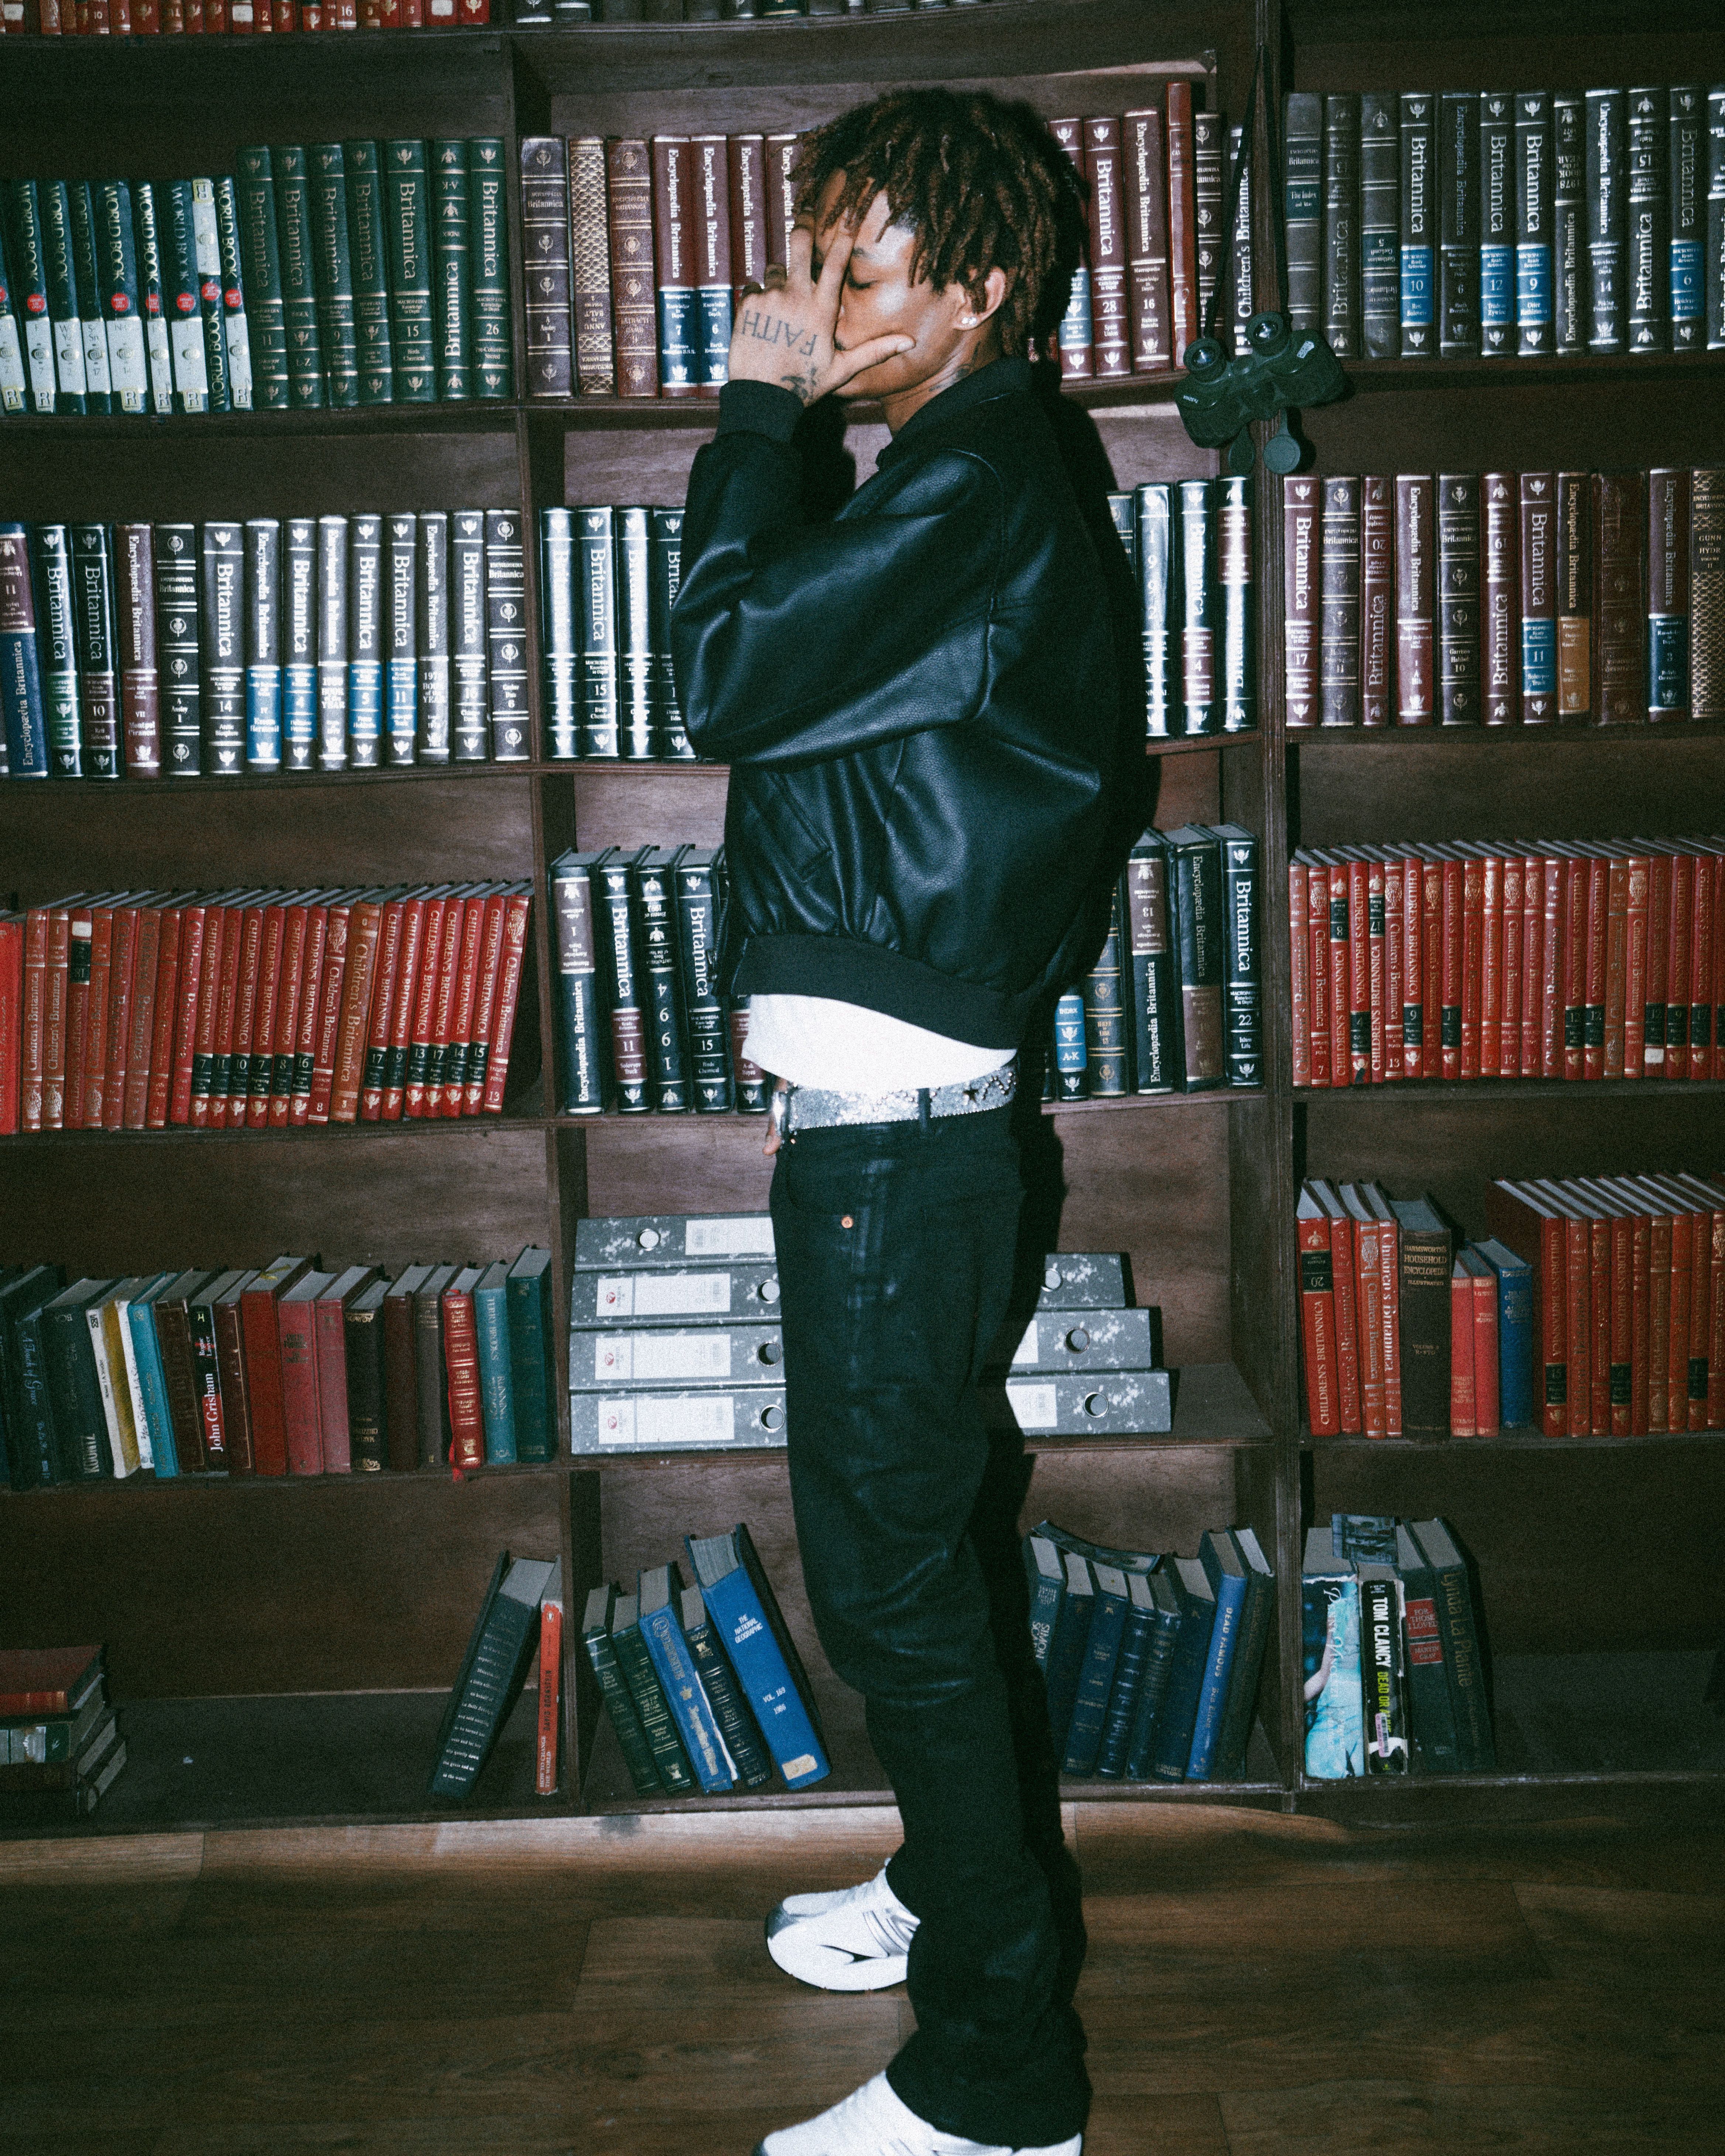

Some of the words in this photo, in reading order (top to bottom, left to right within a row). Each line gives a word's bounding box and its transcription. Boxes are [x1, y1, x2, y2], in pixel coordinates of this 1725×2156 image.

[341, 6, 353, 16] 16
[1639, 155, 1651, 166] 15
[218, 180, 233, 237] WORLD
[1097, 159, 1113, 256] Britannica
[1412, 137, 1427, 234] Britannica
[18, 184, 33, 237] WORLD
[49, 186, 64, 237] WORLD
[104, 186, 121, 238] WORLD
[138, 185, 155, 238] WORLD
[482, 182, 498, 277] Britannica
[1140, 197, 1150, 252] Britannica
[222, 237, 237, 278] BOOK
[251, 192, 270, 289] Britannica
[285, 190, 305, 286] Britannica
[320, 187, 339, 284] Britannica
[671, 223, 682, 278] Britannica
[707, 222, 719, 277] Britannica
[24, 242, 38, 281] BOOK
[54, 243, 68, 282] BOOK
[110, 243, 125, 282] BOOK
[145, 242, 159, 282] BOOK
[1411, 281, 1423, 291] 10
[1491, 280, 1502, 291] 12
[1530, 279, 1537, 290] 9
[1600, 281, 1611, 291] 14
[1636, 213, 1652, 310] Britannica
[1684, 276, 1691, 285] 6
[445, 262, 460, 357] Britannica
[1103, 301, 1116, 312] 28
[1144, 299, 1155, 309] 16
[208, 310, 220, 351] BOOK
[407, 326, 419, 336] 15
[486, 324, 499, 335] 26
[676, 326, 681, 335] 7
[743, 309, 817, 357] FAITH
[209, 356, 225, 406] WORLD
[1296, 516, 1311, 610] Britannica
[1372, 539, 1386, 550] 20
[1532, 513, 1547, 607] Britannica
[294, 560, 310, 653] Britannica
[359, 556, 376, 649] Britannica
[394, 555, 410, 647] Britannica
[463, 552, 478, 644] Britannica
[591, 548, 606, 641] Britannica
[1412, 557, 1421, 611] Britannica
[1569, 555, 1579, 609] Britannica
[47, 567, 67, 659] Britannica
[85, 566, 104, 659] Britannica
[131, 608, 142, 661] Britannica
[217, 563, 233, 657] Britannica
[1295, 654, 1307, 665] 17
[1534, 651, 1543, 662] 11
[93, 706, 104, 716] 10
[219, 701, 232, 712] 14
[594, 684, 606, 695] 15
[1354, 876, 1364, 938] CHILDREN'S
[1409, 870, 1418, 931] CHILDREN'S
[383, 913, 397, 975] CHILDREN'S
[404, 913, 417, 974] CHILDREN'S
[426, 910, 439, 972] CHILDREN'S
[443, 912, 456, 972] CHILDREN'S
[464, 909, 477, 970] CHILDREN'S
[486, 909, 500, 970] CHILDREN'S
[1237, 880, 1251, 971] Britannica
[205, 920, 217, 981] CHILDREN'S
[690, 907, 707, 997] Britannica
[1316, 930, 1325, 976] Children's
[1355, 942, 1364, 1004] BRITANNICA
[1409, 935, 1418, 996] BRITANNICA
[350, 943, 369, 1011] Children's
[1147, 962, 1156, 1014] Britannica
[1336, 951, 1344, 1011] BRITANNICA
[1372, 945, 1380, 1007] BRITANNICA
[200, 985, 213, 1046] BRITANNICA
[376, 978, 390, 1039] BRITANNICA
[396, 978, 410, 1038] BRITANNICA
[417, 975, 432, 1035] BRITANNICA
[436, 976, 450, 1037] BRITANNICA
[457, 974, 471, 1034] BRITANNICA
[478, 974, 493, 1034] BRITANNICA
[1239, 1015, 1251, 1025] 22
[1316, 978, 1326, 1027] Britannica
[1591, 1011, 1601, 1020] 12
[298, 1058, 308, 1067] 16
[341, 1015, 360, 1081] Britannica
[372, 1054, 383, 1063] 17
[415, 1049, 425, 1058] 13
[433, 1050, 443, 1058] 17
[454, 1048, 464, 1057] 14
[474, 1047, 484, 1057] 15
[623, 1041, 634, 1052] 11
[702, 1040, 713, 1050] 15
[1337, 1014, 1346, 1075] CHILDREN'S
[1372, 1009, 1381, 1070] CHILDREN'S
[1389, 1058, 1400, 1067] 13
[237, 1060, 247, 1069] 10
[317, 1103, 322, 1111] 8
[489, 1092, 500, 1101] 13
[1311, 1277, 1324, 1287] 20
[1404, 1256, 1447, 1264] HOUSEHOLD
[488, 1328, 498, 1360] BROOKS
[1315, 1301, 1325, 1360] BRITANNICA
[205, 1373, 218, 1424] Grisham
[1318, 1364, 1329, 1425] CHILDREN'S
[82, 1434, 99, 1473] KOONTZ
[210, 1424, 223, 1452] John
[1372, 1597, 1389, 1621] TOM
[1410, 1614, 1435, 1623] THOSE
[1444, 1572, 1462, 1616] Lynda
[734, 1617, 759, 1635] NATIONAL
[735, 1623, 763, 1644] GEOGRAPHIC
[738, 1615, 748, 1624] THE
[1035, 1624, 1050, 1659] SIMON
[1223, 1607, 1233, 1634] DEAD
[1451, 1617, 1465, 1637] La
[1215, 1637, 1227, 1678] FAMOUS
[1374, 1625, 1391, 1668] CLANCY
[1453, 1638, 1472, 1688] Plante
[763, 1693, 775, 1703] VOL.
[776, 1687, 786, 1697] 169
[1377, 1671, 1388, 1694] DEAD
[1378, 1696, 1389, 1707] OR
[773, 1703, 786, 1715] 1986
[541, 1762, 546, 1771] TO
